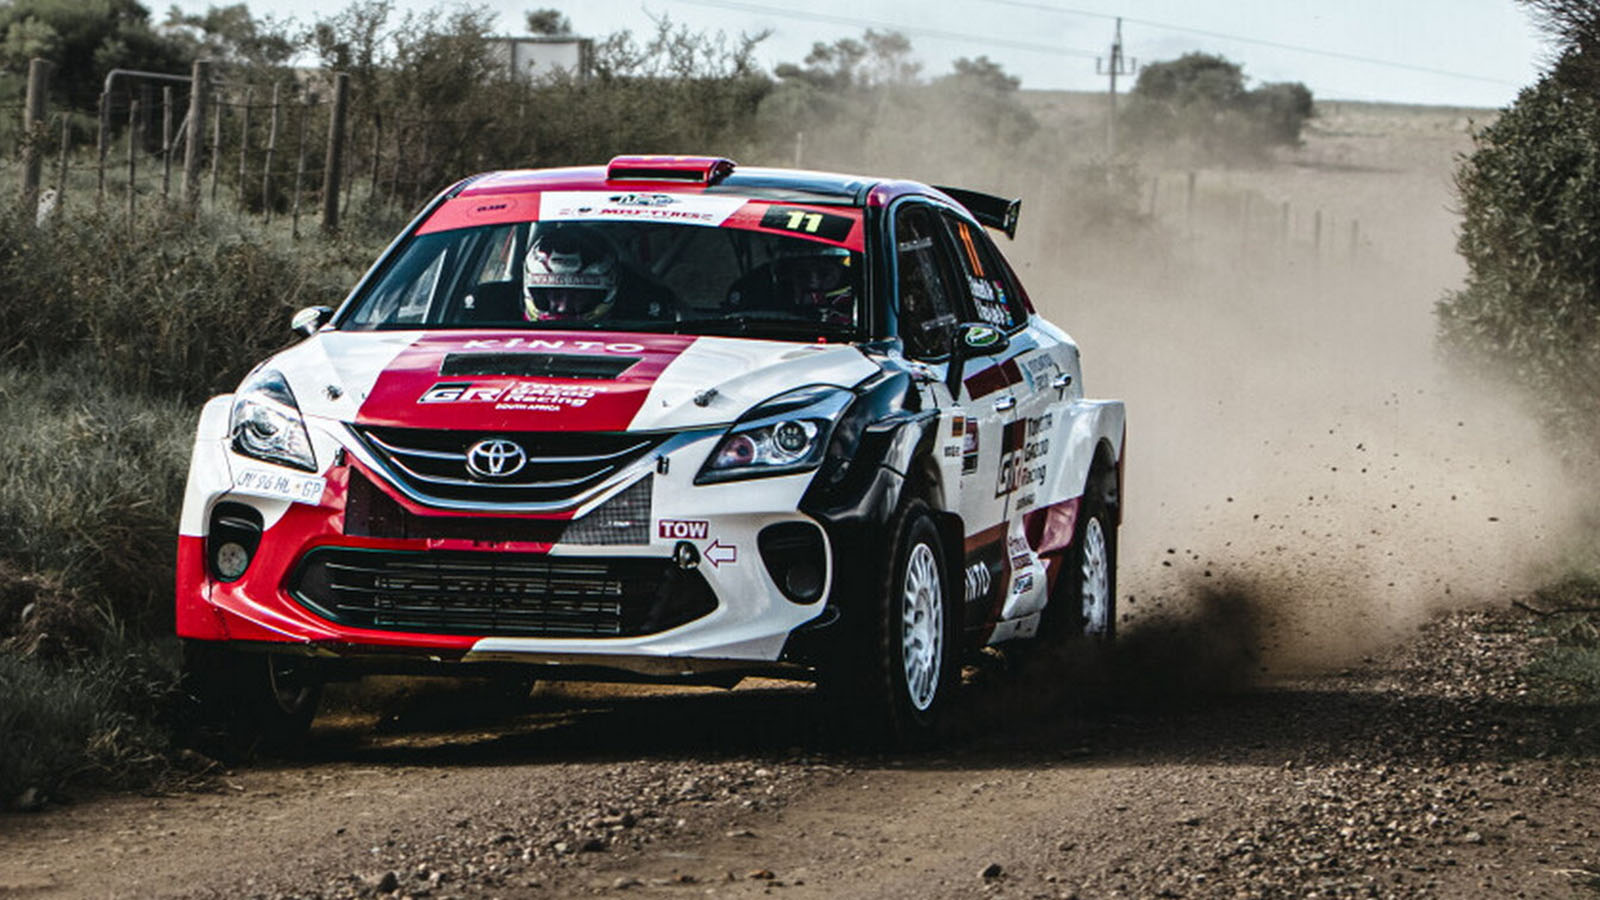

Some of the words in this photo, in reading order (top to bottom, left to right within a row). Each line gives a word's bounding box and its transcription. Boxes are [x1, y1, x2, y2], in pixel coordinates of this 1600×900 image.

[650, 210, 700, 219] TYRES
[786, 211, 823, 232] 11
[957, 222, 984, 277] 11
[463, 338, 645, 353] KINTO
[420, 387, 501, 402] GR
[503, 393, 588, 407] Racing
[528, 404, 561, 412] AFRICA
[1020, 465, 1046, 486] Racing
[301, 480, 321, 498] GP
[660, 522, 706, 537] TOW
